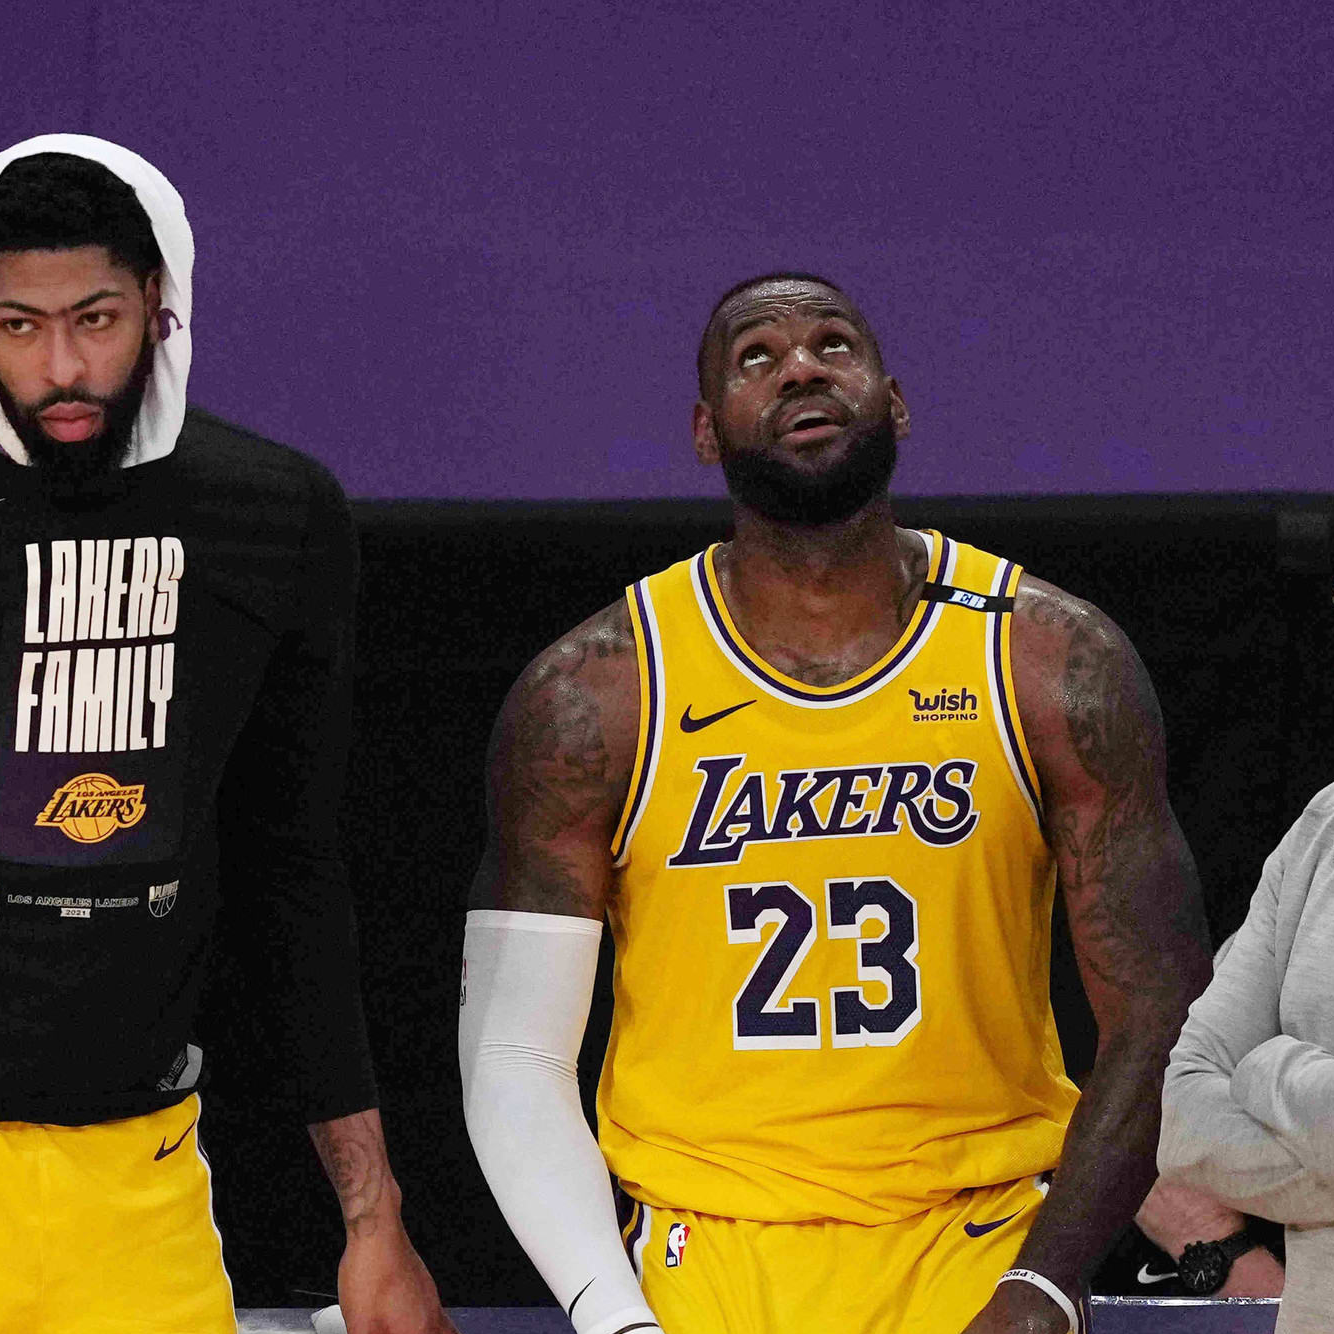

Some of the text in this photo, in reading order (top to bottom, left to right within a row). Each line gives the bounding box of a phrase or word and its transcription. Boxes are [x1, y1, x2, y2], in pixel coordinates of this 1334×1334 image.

[24, 536, 184, 644] LAKERS
[15, 643, 175, 752] FAMILY
[908, 687, 977, 711] wish
[913, 713, 978, 722] SHOPPING
[96, 788, 140, 797] ANGELES
[42, 791, 142, 825] LAKERS
[667, 753, 981, 869] LAKERS
[7, 894, 140, 908] LOS ANGELES LAKERS
[66, 909, 87, 917] 2021
[723, 875, 922, 1051] 23
